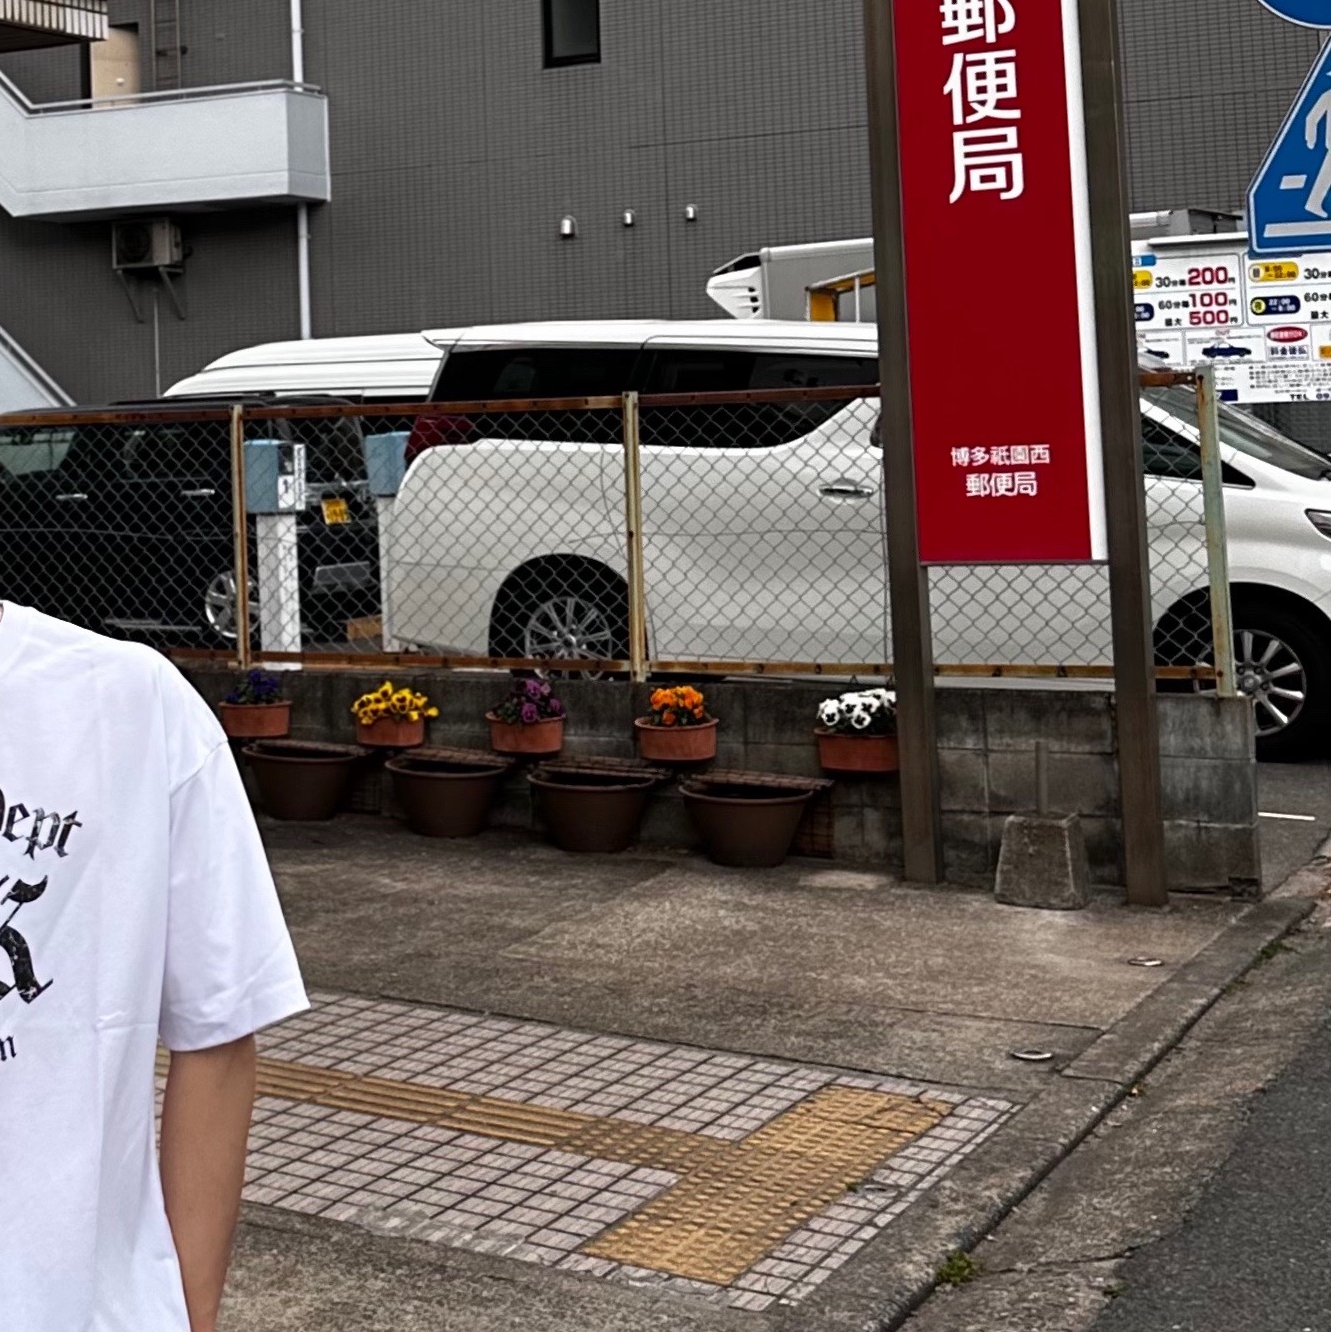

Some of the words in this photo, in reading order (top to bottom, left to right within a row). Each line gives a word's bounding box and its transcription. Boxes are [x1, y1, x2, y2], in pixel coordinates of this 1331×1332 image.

[939, 0, 1025, 204] 郵便局
[950, 444, 1050, 467] 博多祇園西
[965, 471, 1038, 497] 郵便局
